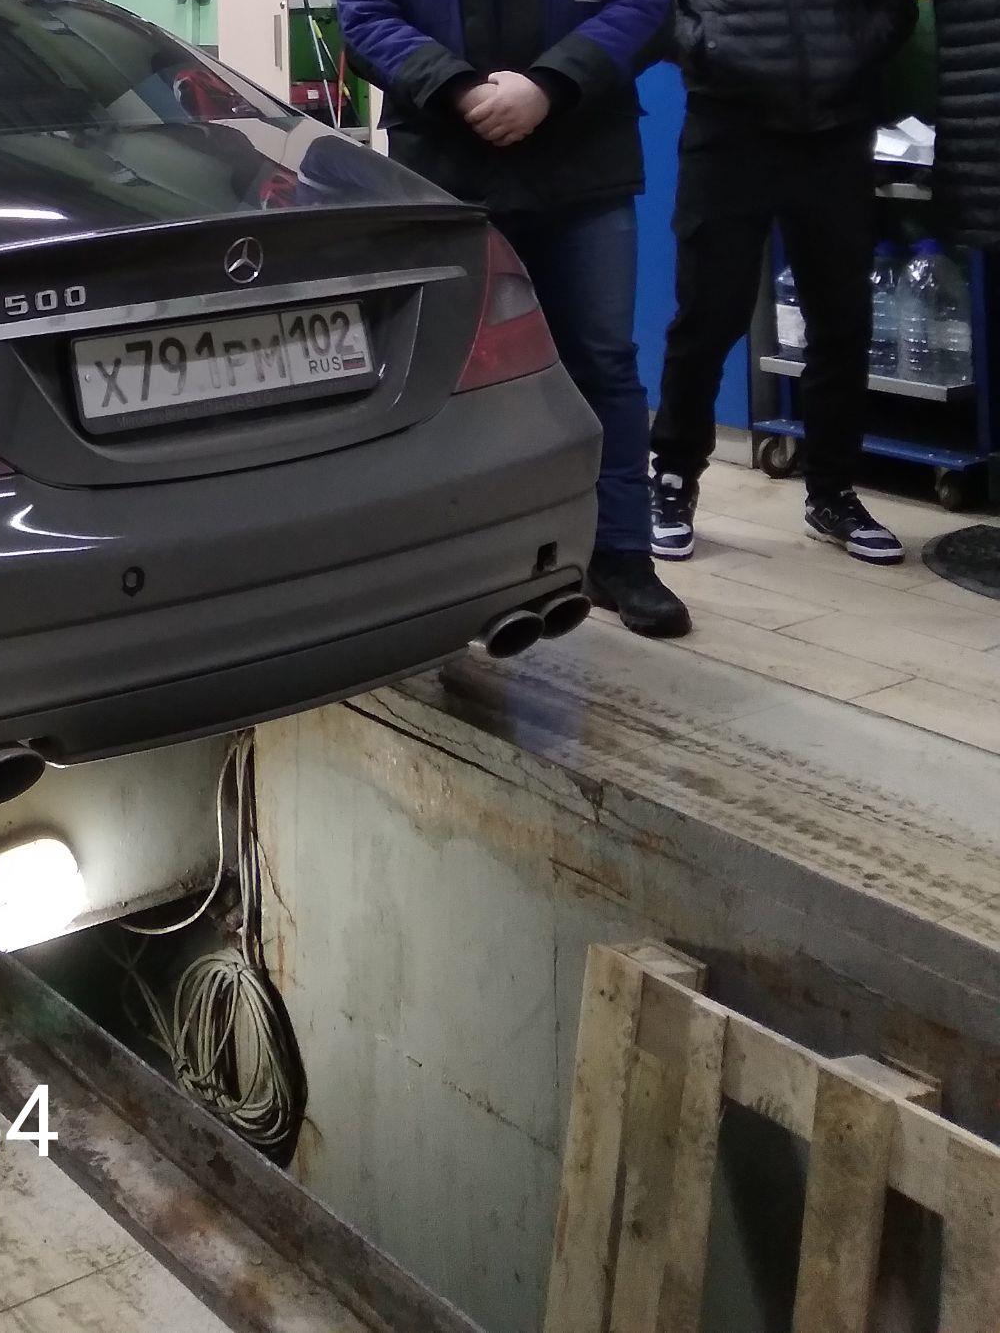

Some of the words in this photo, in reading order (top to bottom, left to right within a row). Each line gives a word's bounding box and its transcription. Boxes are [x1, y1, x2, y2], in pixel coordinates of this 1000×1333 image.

[4, 285, 87, 316] 500
[288, 311, 355, 359] 102
[309, 356, 342, 375] RUS
